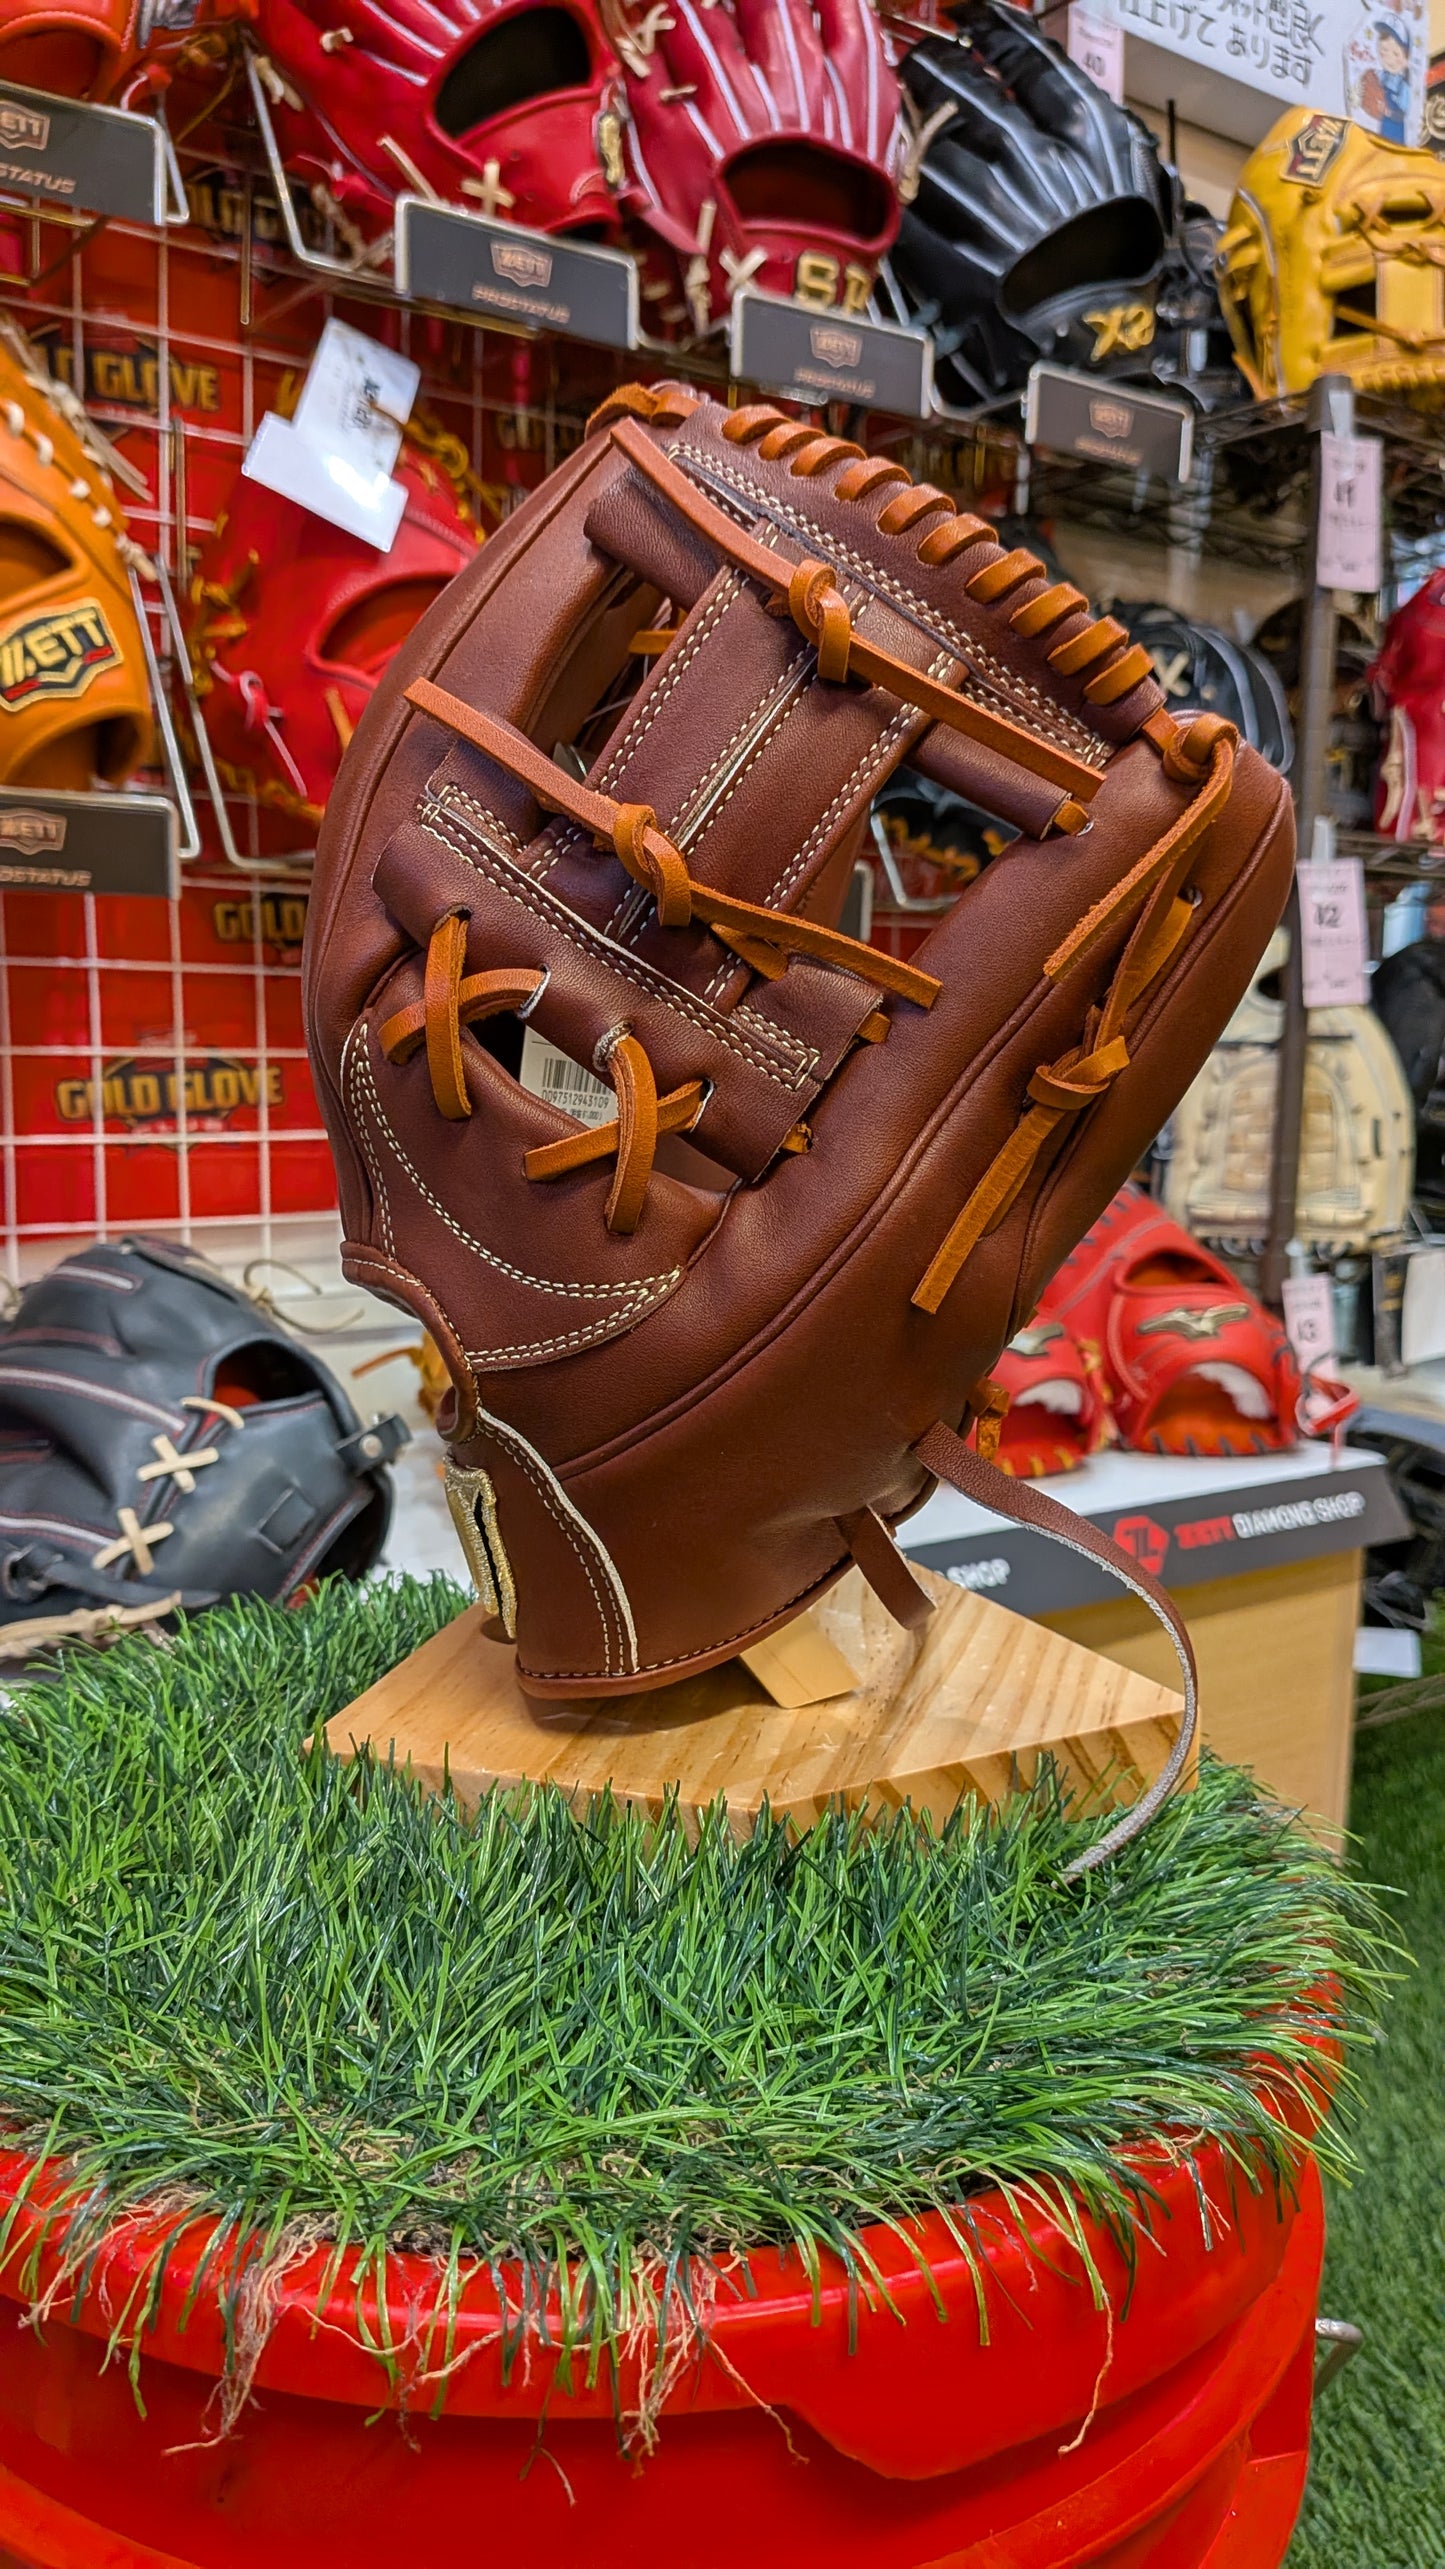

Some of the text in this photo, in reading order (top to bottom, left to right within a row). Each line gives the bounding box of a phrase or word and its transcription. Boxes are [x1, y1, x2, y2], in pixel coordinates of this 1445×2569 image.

[57, 1066, 284, 1119] GOLD GLOVE
[1232, 1500, 1319, 1540] DIAMOND
[1313, 1490, 1367, 1523] SHOP
